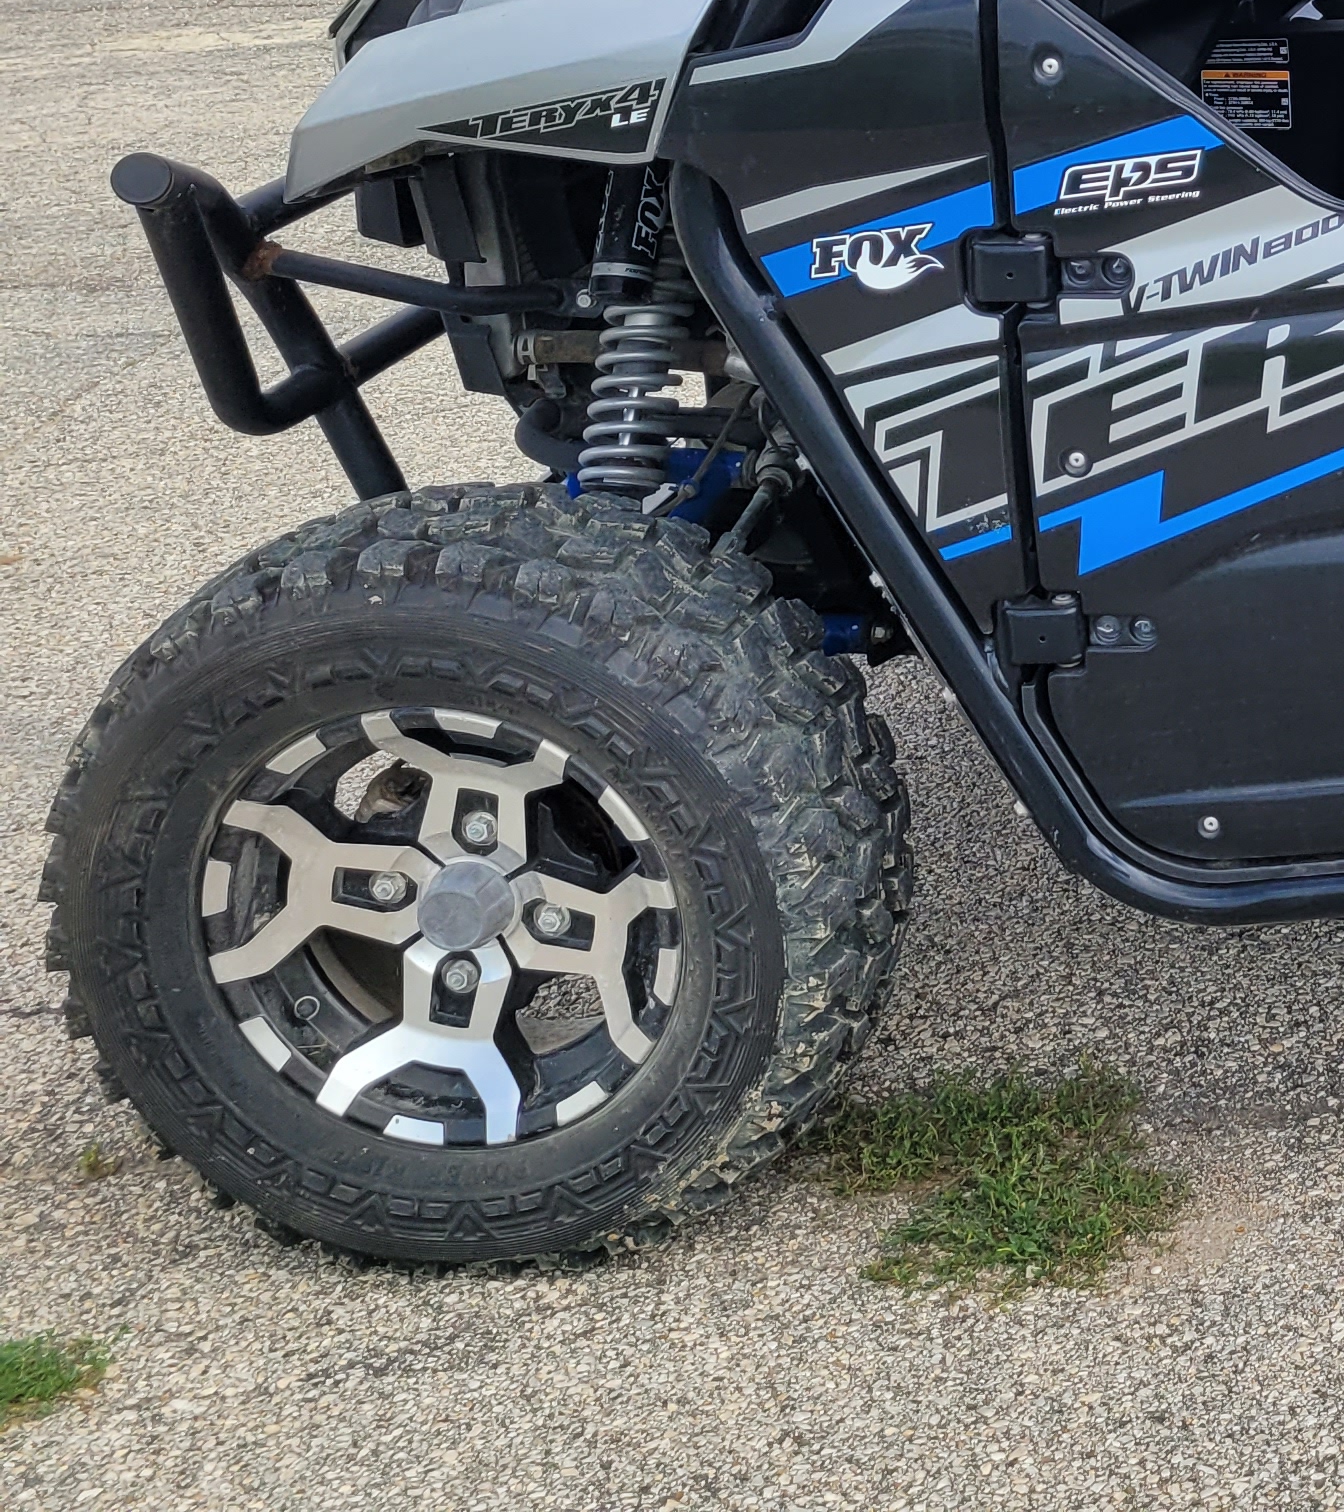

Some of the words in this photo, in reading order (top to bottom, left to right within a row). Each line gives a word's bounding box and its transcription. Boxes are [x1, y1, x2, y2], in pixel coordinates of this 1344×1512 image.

[610, 108, 650, 128] LE
[1059, 149, 1202, 201] EPS
[631, 165, 667, 260] FOX
[1054, 203, 1100, 216] Electric
[1104, 197, 1143, 209] Power
[1147, 190, 1201, 203] Steering
[810, 222, 936, 281] FOX
